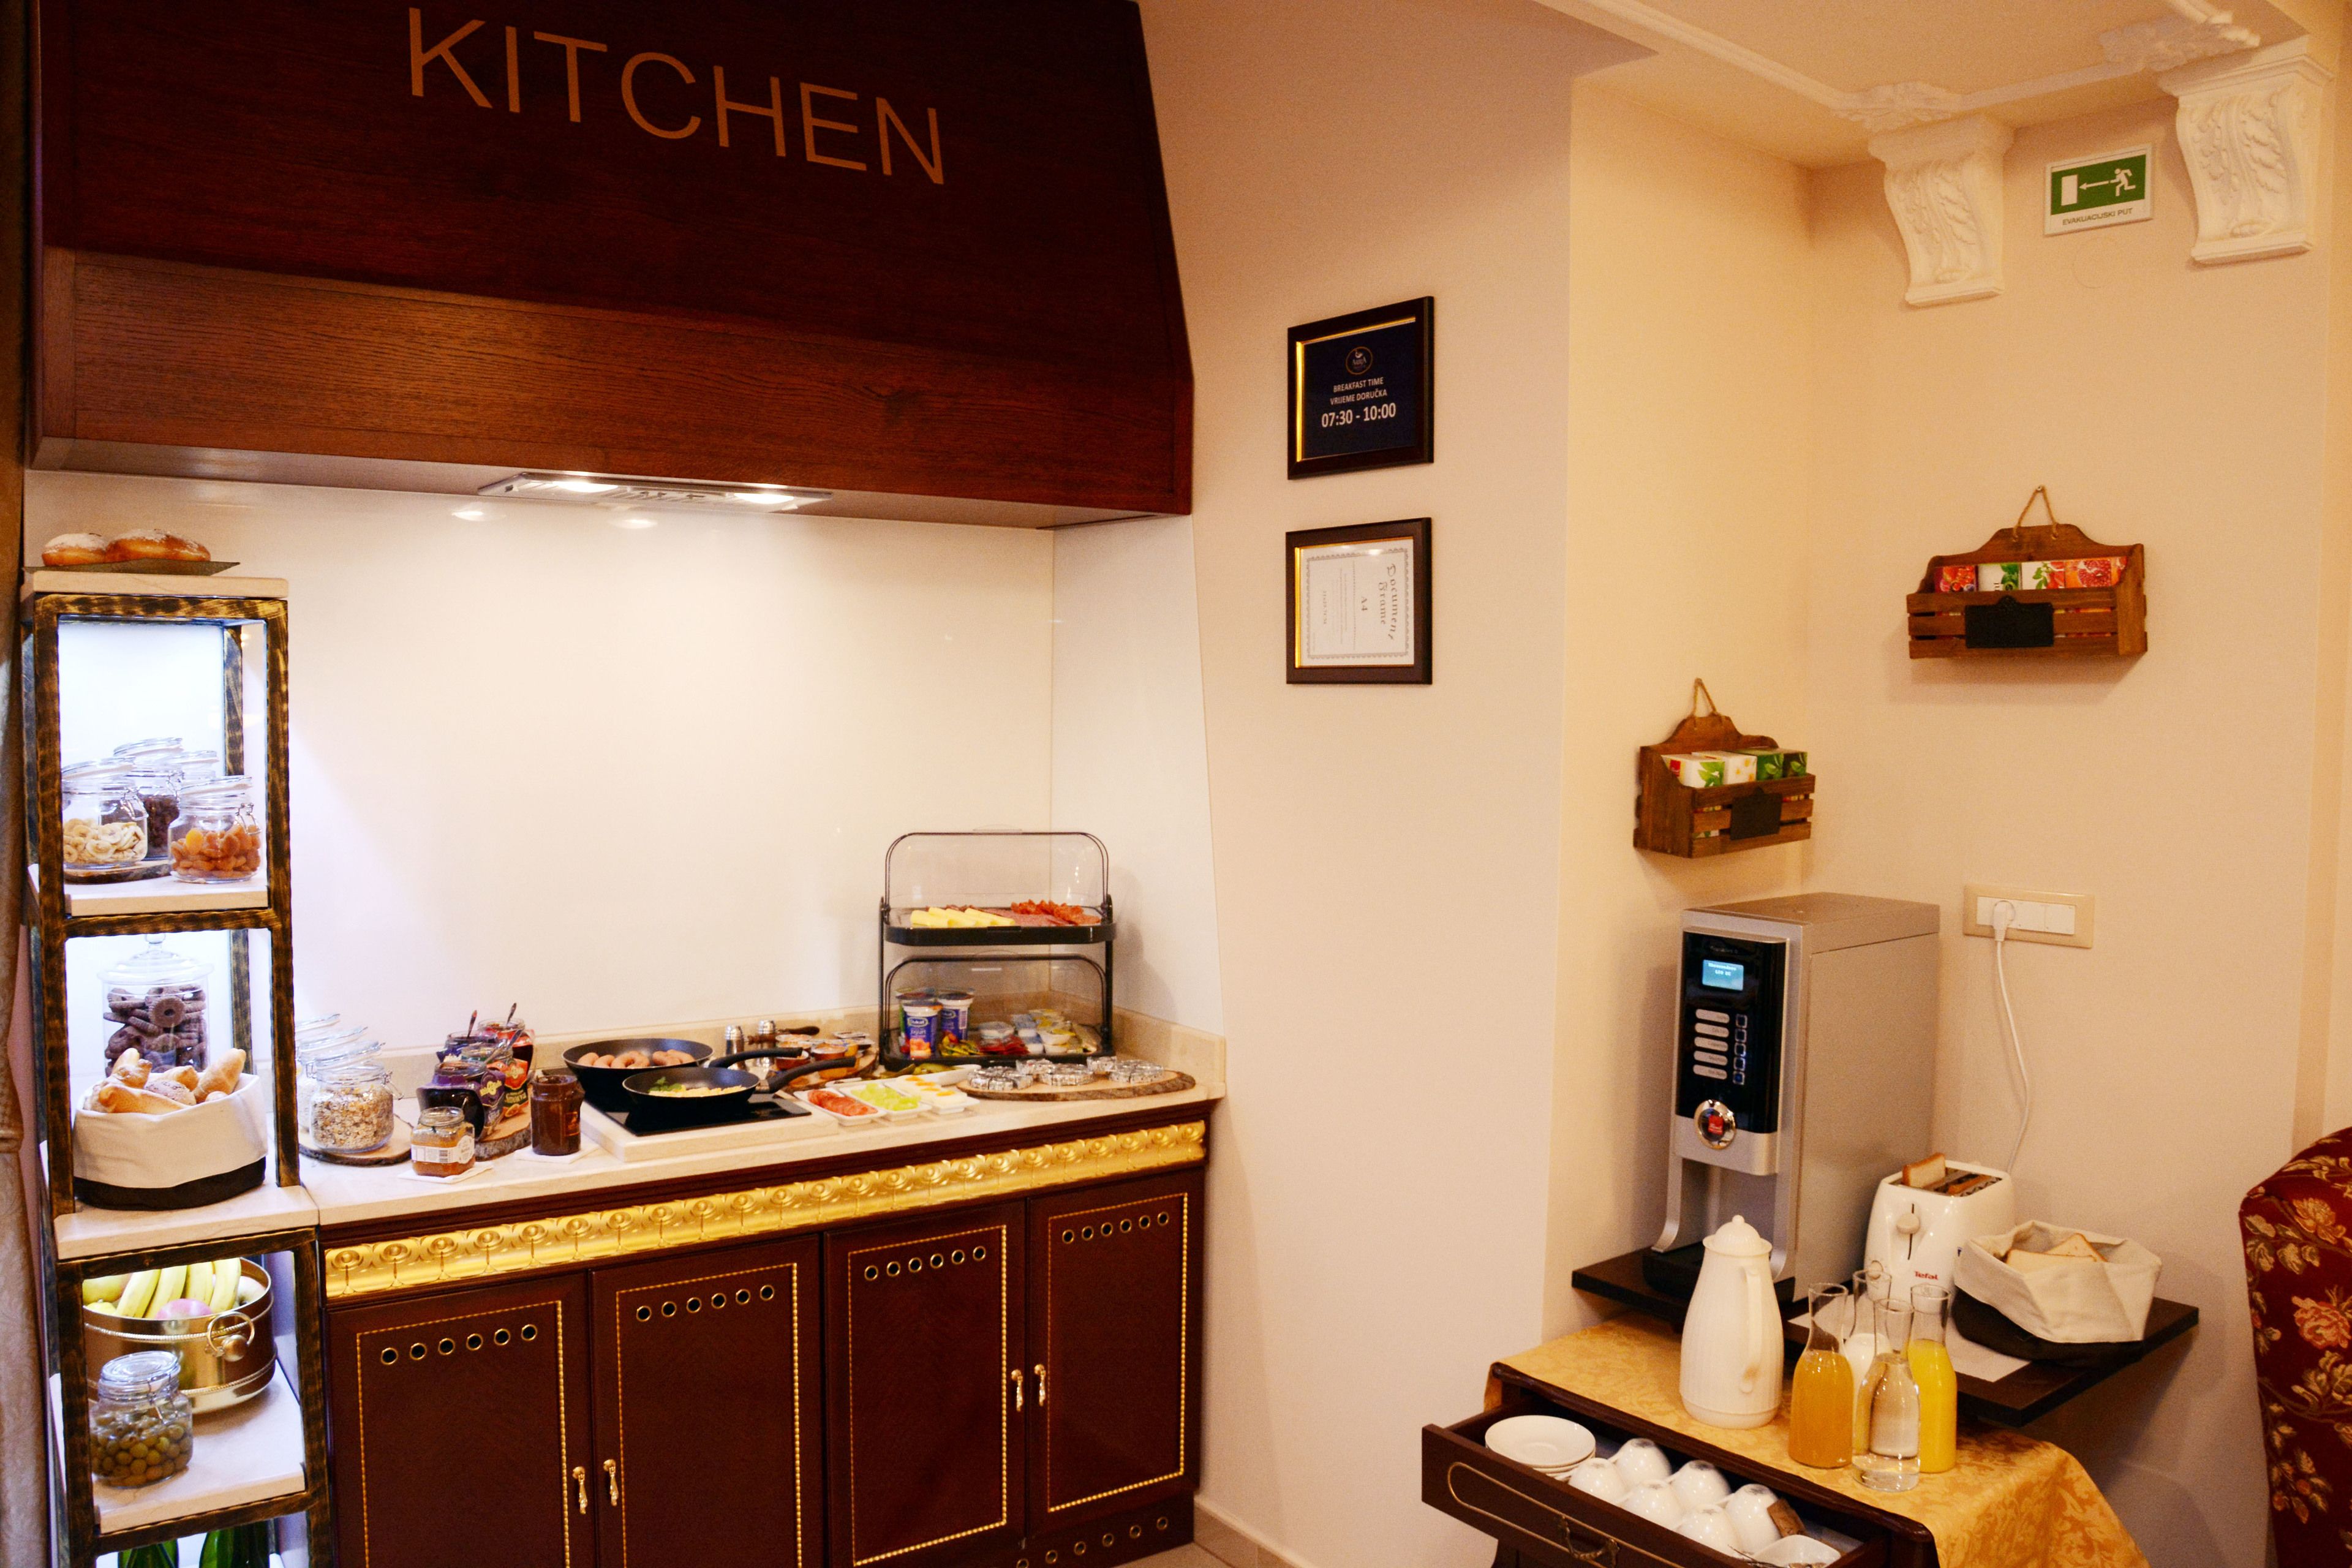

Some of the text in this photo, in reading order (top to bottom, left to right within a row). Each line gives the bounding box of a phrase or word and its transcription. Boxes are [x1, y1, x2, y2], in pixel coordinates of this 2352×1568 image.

[409, 7, 943, 184] KITCHEN
[2062, 208, 2133, 225] EVAKUACIJSKI PUT
[1333, 377, 1384, 393] BREAKFAST TIME
[1330, 388, 1387, 405] VRIJEME DORUČKA
[1321, 409, 1353, 428] 07:30
[1363, 402, 1396, 421] 10:00
[1360, 596, 1368, 611] A4
[1386, 563, 1398, 641] Document
[1914, 1270, 1939, 1280] Tefal
